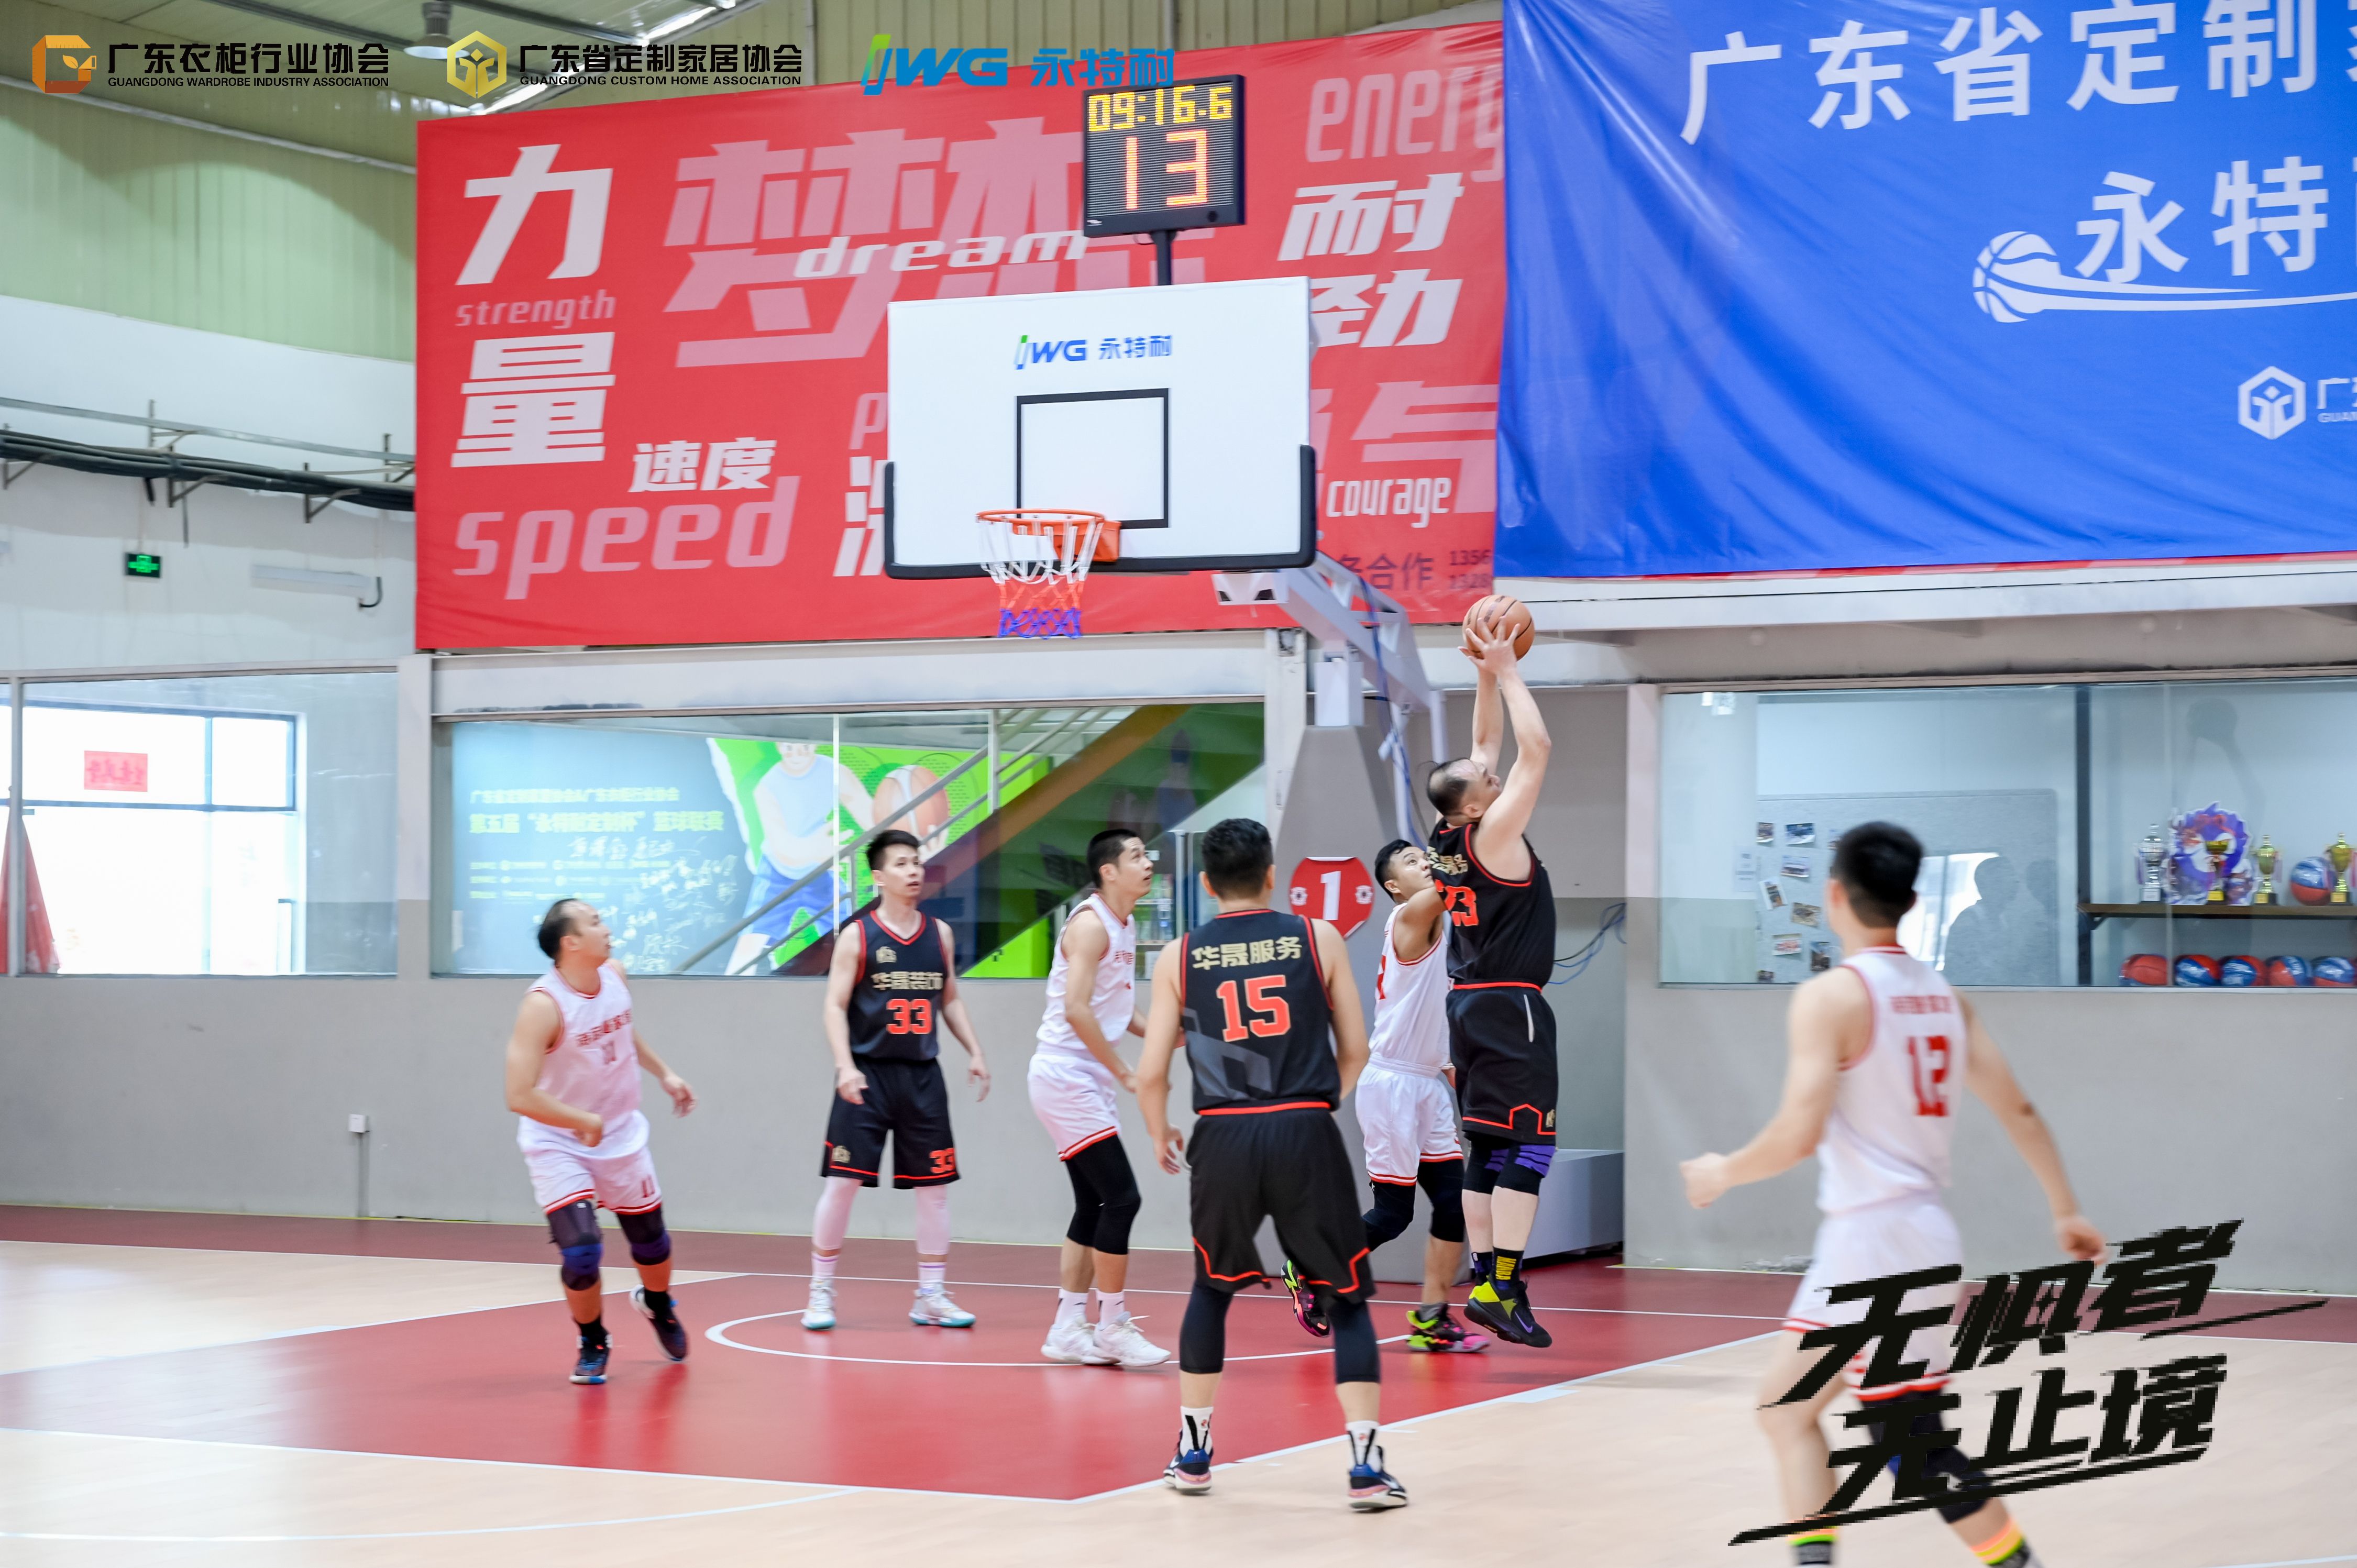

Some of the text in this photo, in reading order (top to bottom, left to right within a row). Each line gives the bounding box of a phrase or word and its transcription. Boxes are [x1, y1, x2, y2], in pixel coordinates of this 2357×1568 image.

[1680, 0, 2357, 145] 广东省定制
[1088, 85, 1232, 131] 09:16.6
[1126, 130, 1208, 209] 13
[2075, 156, 2357, 283] 永特
[793, 230, 1089, 279] dream
[456, 289, 617, 329] strength
[1098, 335, 1172, 359] 永特耐
[628, 437, 777, 493] 速度
[1326, 477, 1452, 528] courage
[452, 476, 801, 600] speed
[1320, 871, 1341, 921] 1
[1191, 936, 1303, 971] 华晟服务
[886, 998, 933, 1034] 33
[1216, 974, 1291, 1043] 15
[1907, 1035, 1950, 1117] 12
